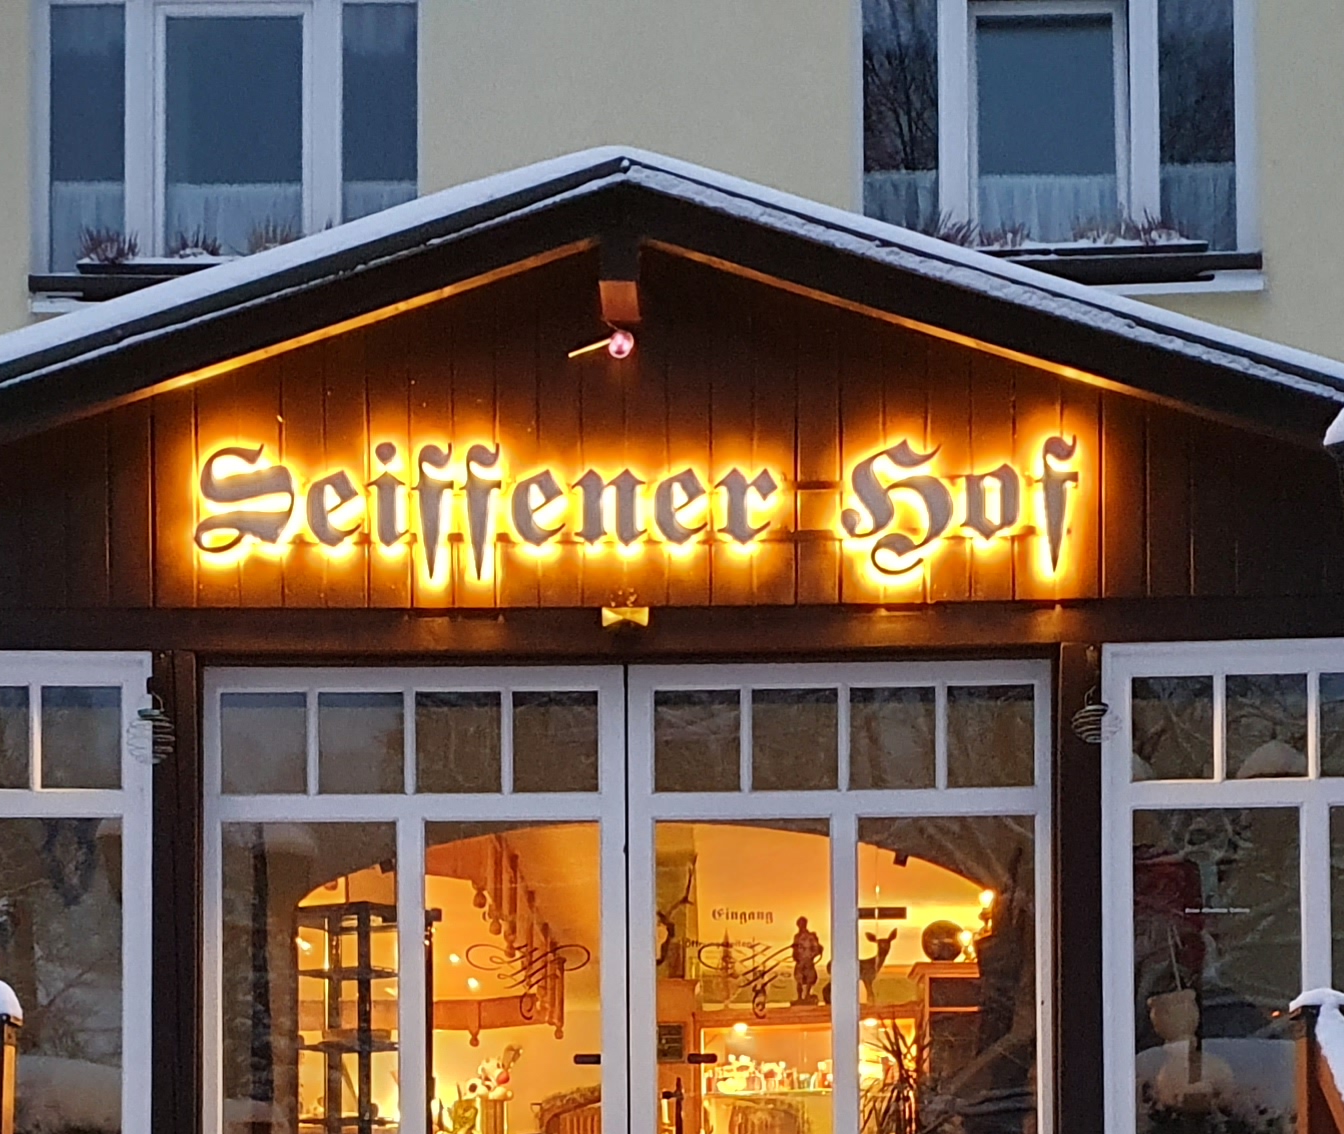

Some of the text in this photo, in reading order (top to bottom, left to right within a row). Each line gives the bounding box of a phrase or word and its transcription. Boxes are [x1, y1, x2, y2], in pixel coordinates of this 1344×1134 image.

[195, 436, 1078, 581] Seiffener Hof
[711, 907, 774, 925] Eingang
